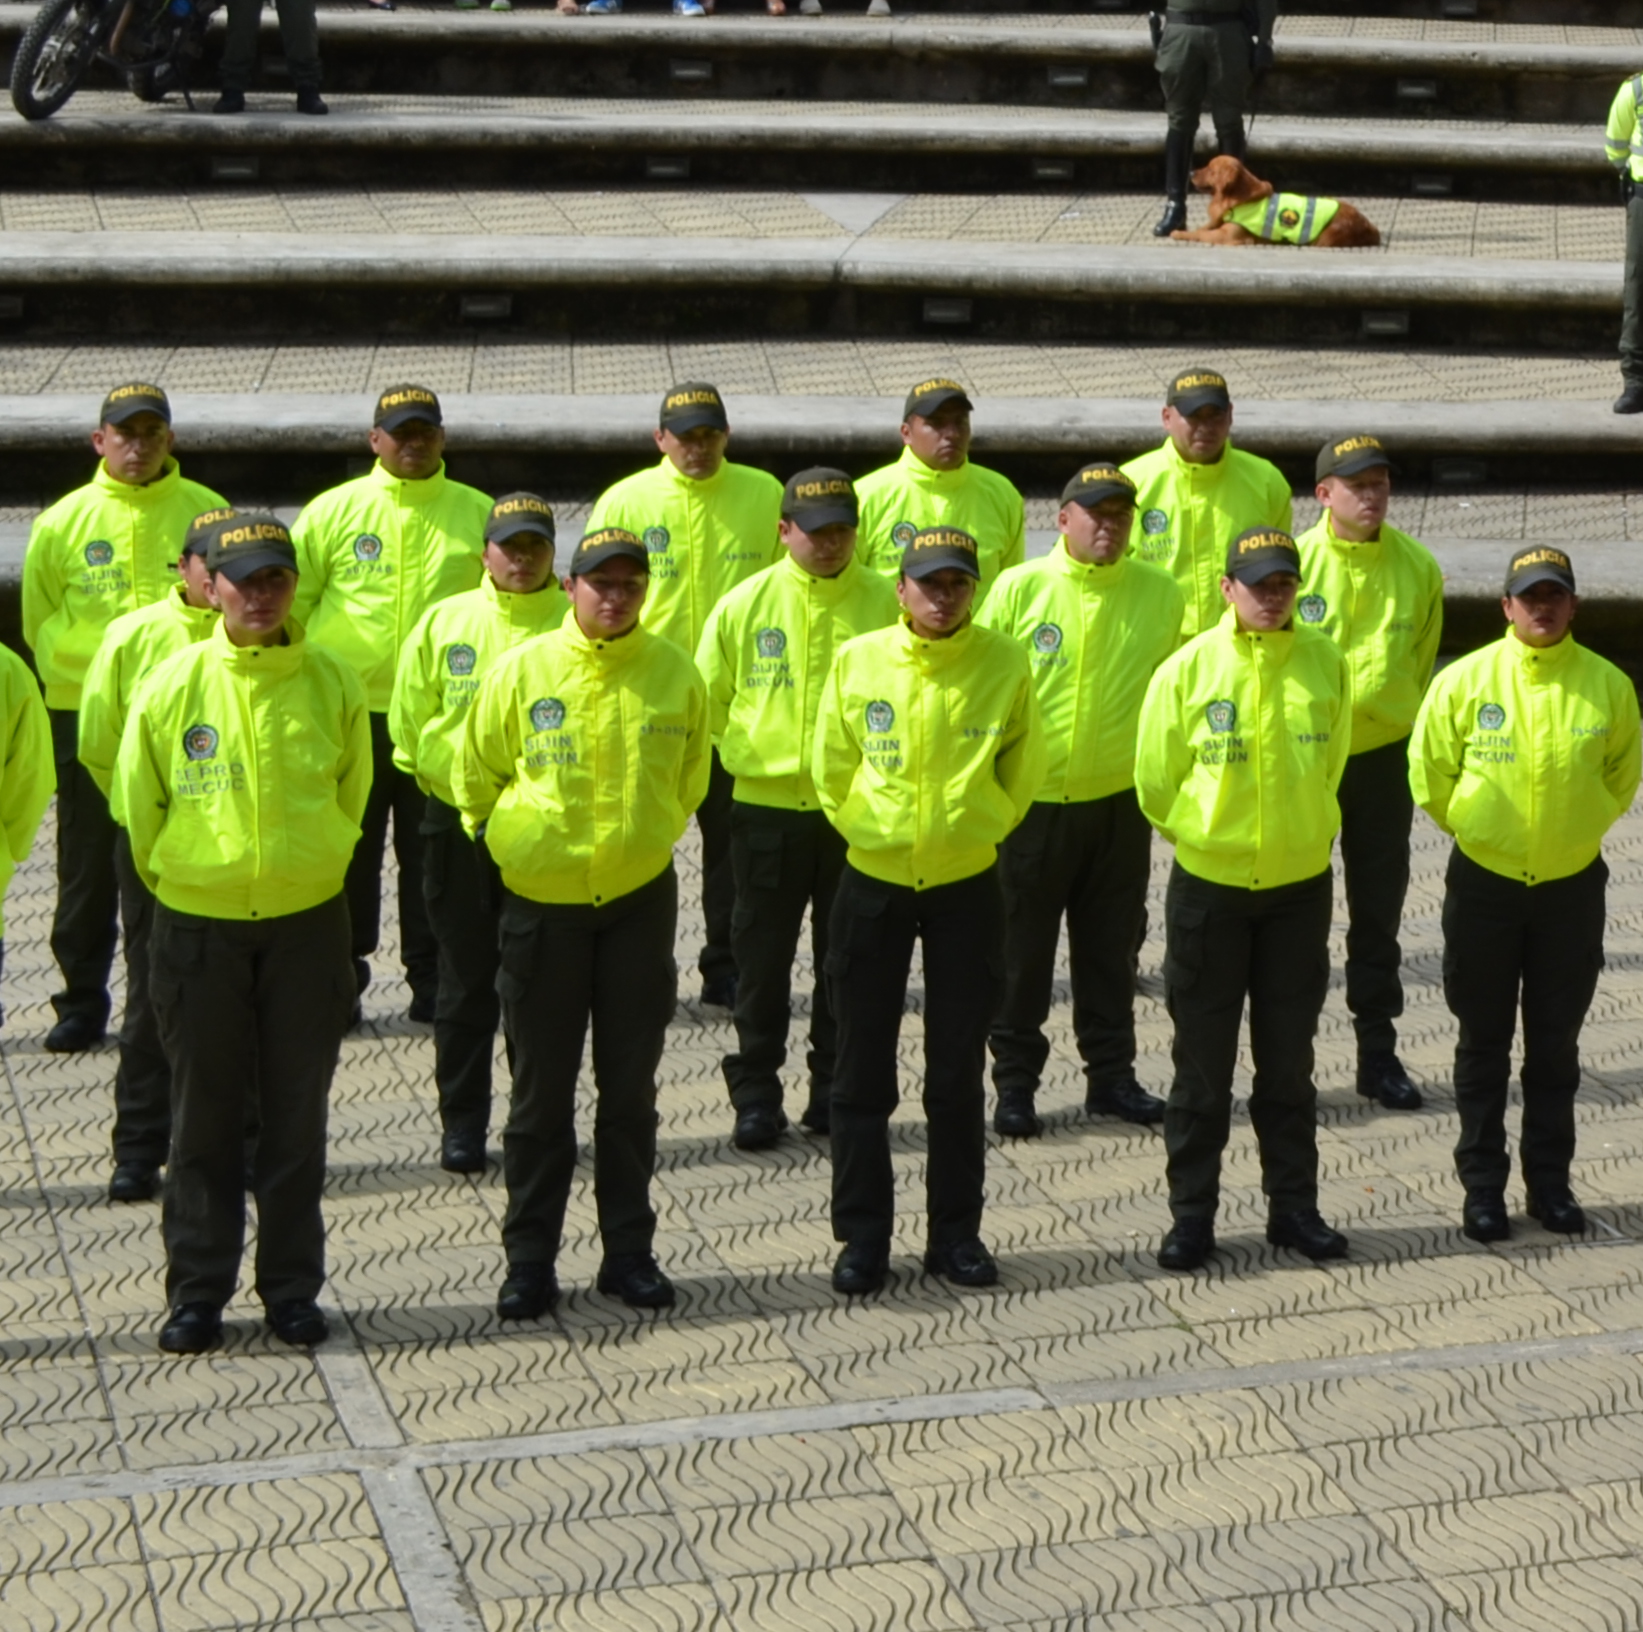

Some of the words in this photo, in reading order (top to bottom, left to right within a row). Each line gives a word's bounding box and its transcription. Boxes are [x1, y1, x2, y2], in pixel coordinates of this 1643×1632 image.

[381, 389, 435, 409] POLICIA
[667, 390, 719, 409] POLICIA
[194, 508, 236, 530] POLI
[220, 523, 289, 549] POLICIA
[914, 532, 974, 552] POLICIA
[1513, 548, 1568, 571] POLICIA
